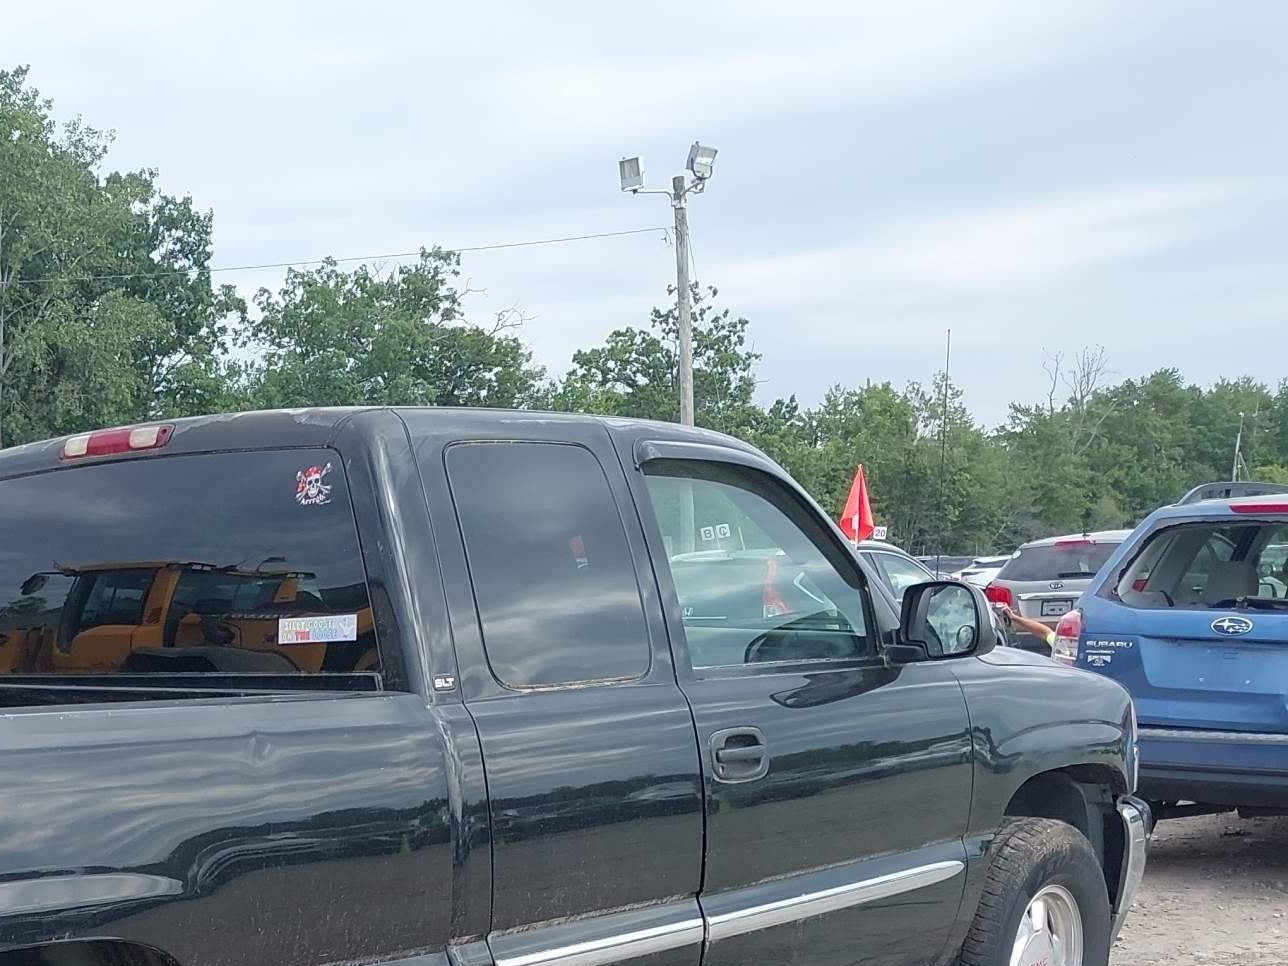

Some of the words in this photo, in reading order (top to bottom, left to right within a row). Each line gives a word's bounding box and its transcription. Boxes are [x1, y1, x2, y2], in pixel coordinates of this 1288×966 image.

[875, 529, 886, 537] 20
[1086, 640, 1133, 648] SUBARU
[434, 677, 454, 688] SLT
